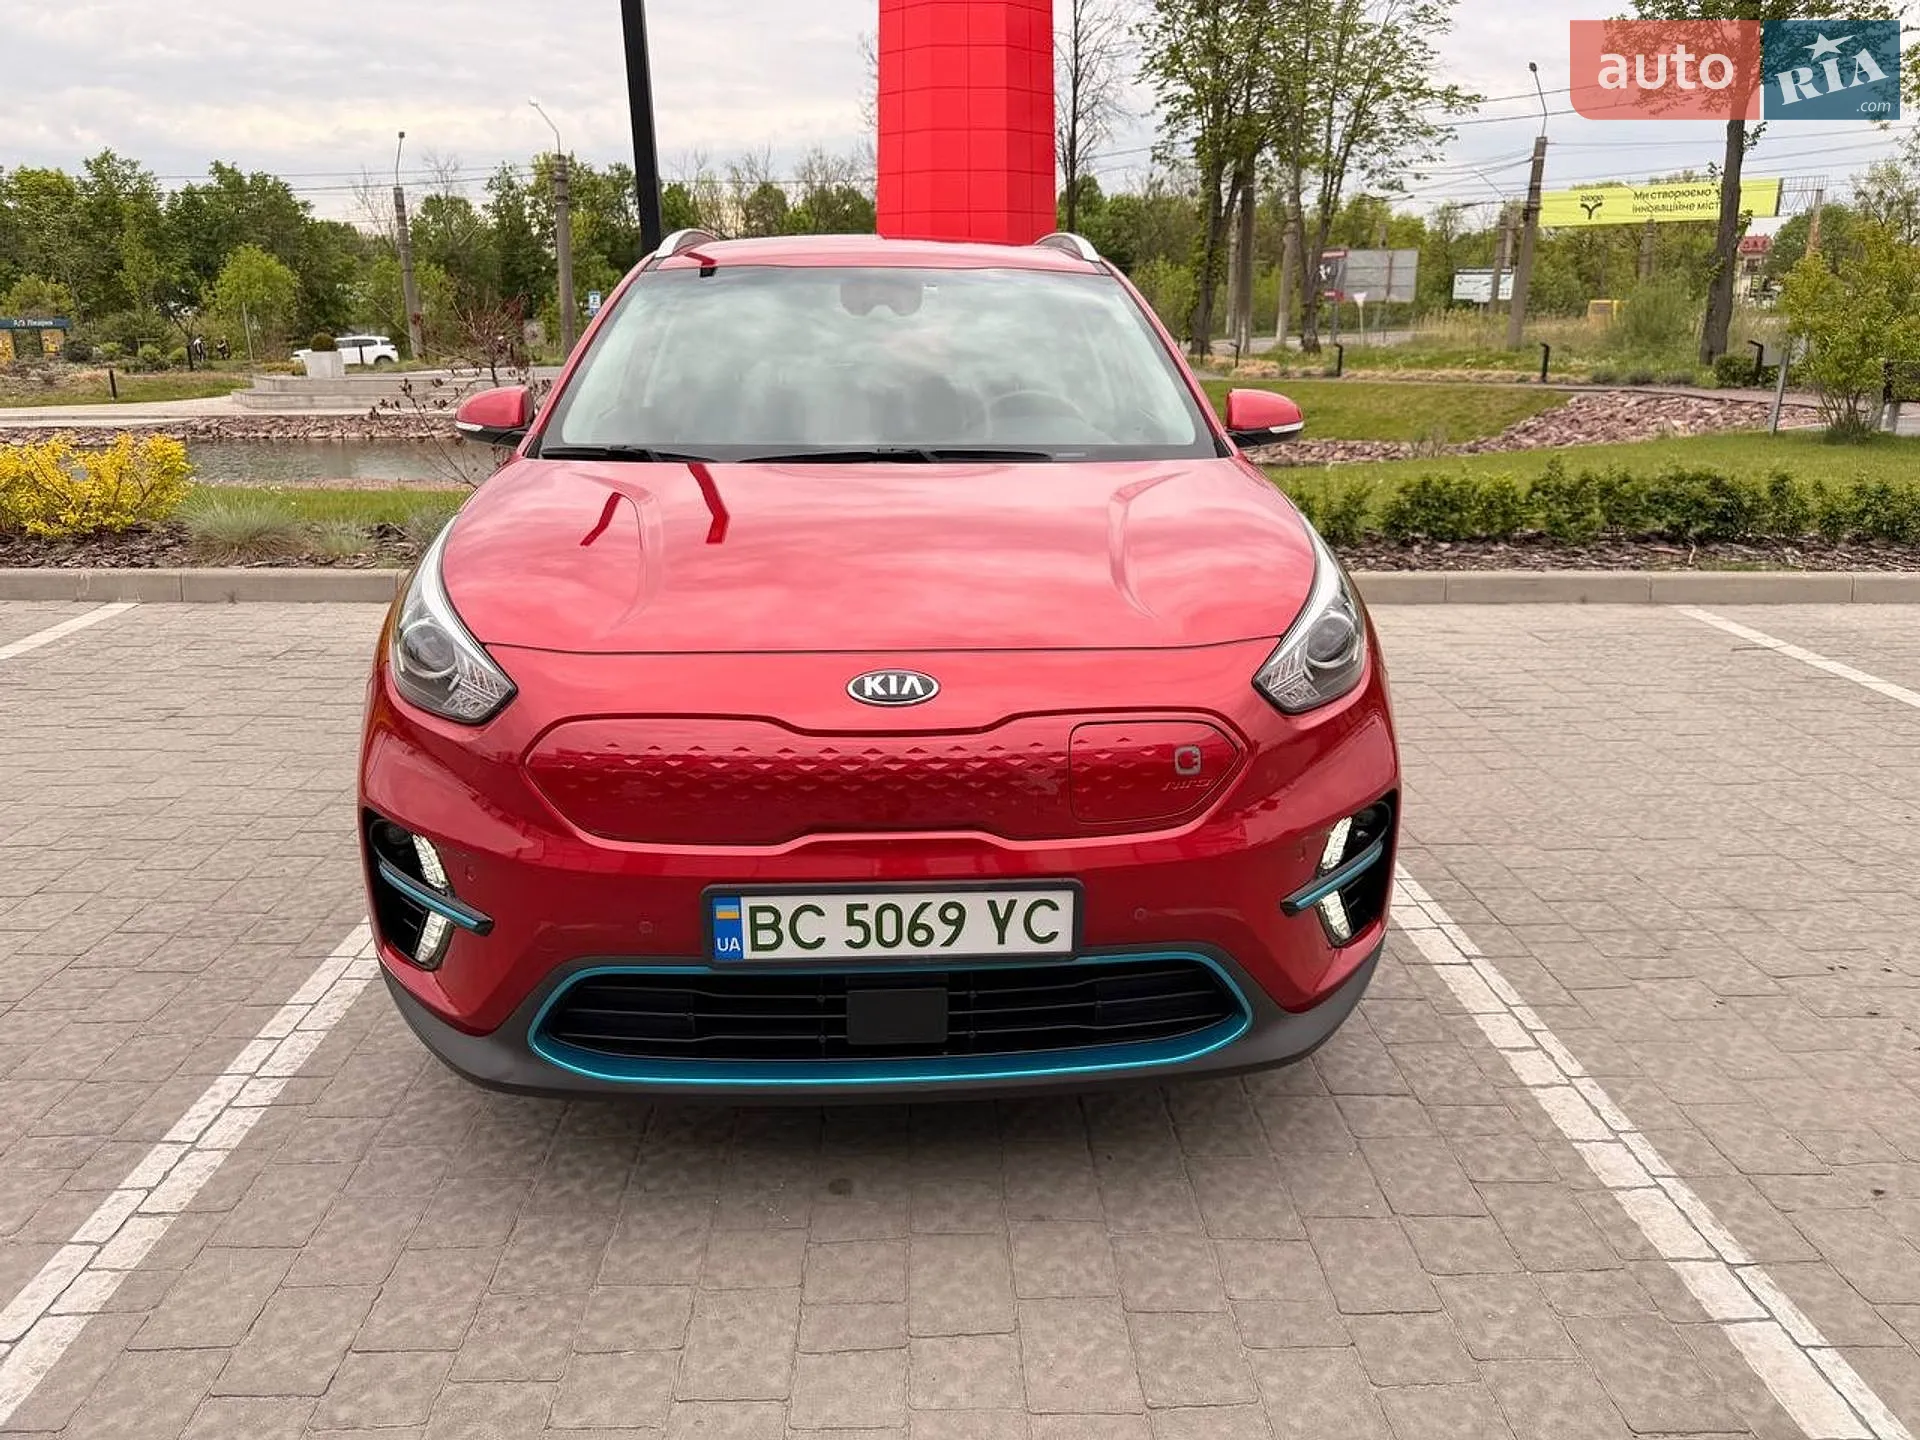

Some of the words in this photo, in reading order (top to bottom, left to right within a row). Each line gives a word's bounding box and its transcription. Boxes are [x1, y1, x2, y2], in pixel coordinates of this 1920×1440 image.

[1633, 191, 1649, 201] Ми
[1650, 189, 1711, 202] створюємо
[863, 674, 924, 697] KIA
[749, 904, 826, 952] BC
[844, 901, 966, 949] 5069
[987, 898, 1059, 945] YC
[716, 936, 741, 952] UA
